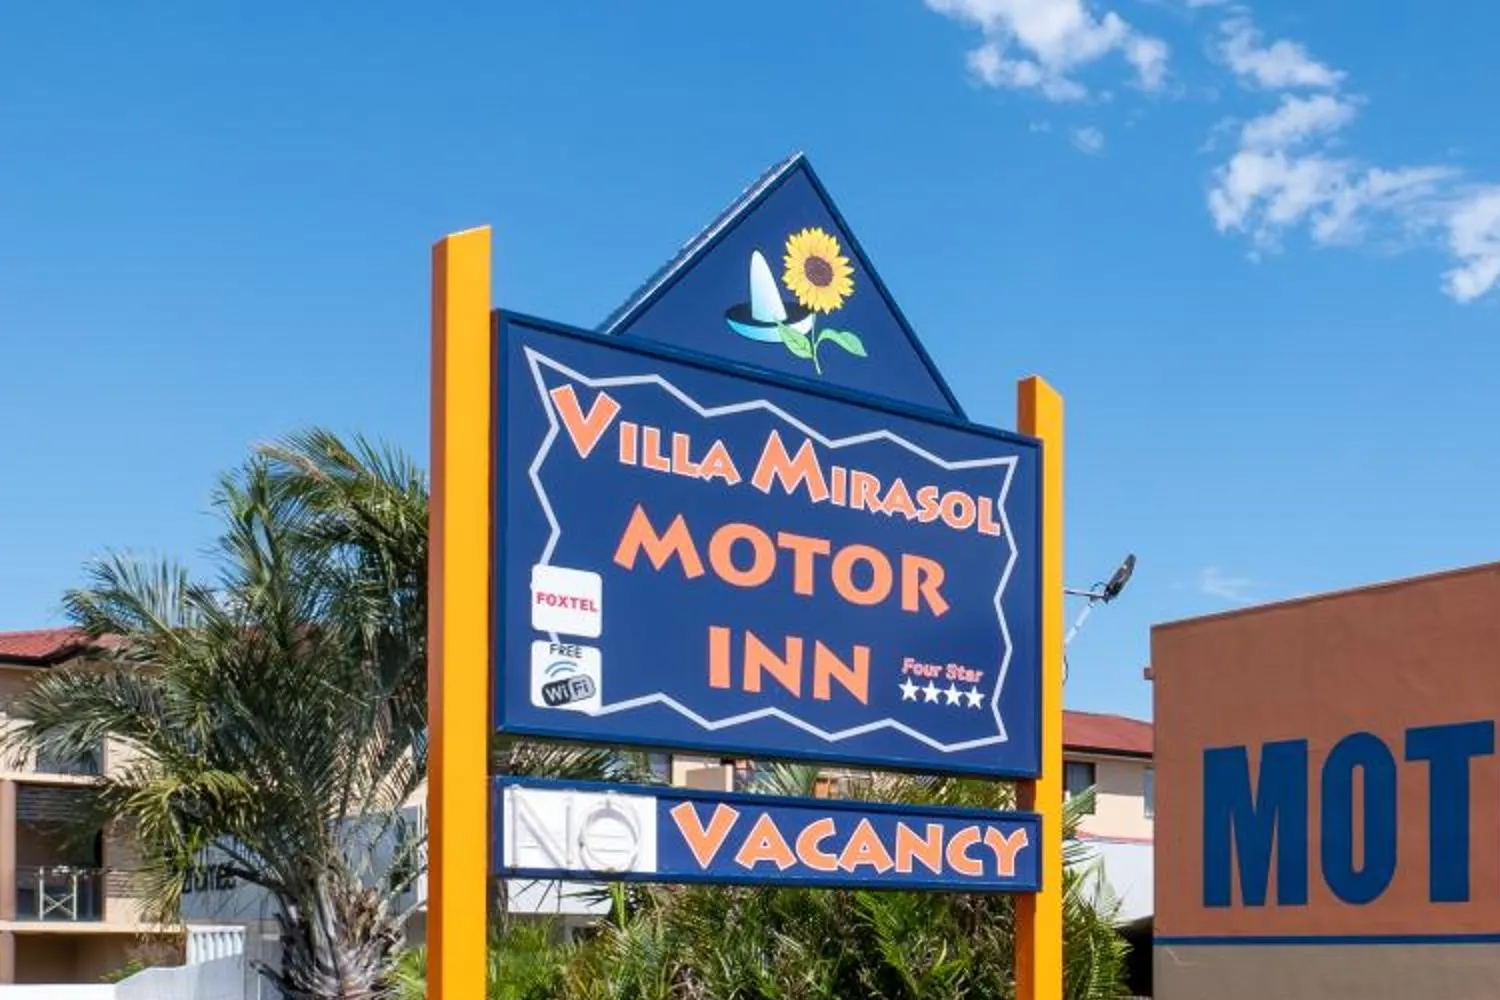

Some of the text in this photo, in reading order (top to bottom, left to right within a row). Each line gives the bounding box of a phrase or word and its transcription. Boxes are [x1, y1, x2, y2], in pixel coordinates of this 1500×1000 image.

[550, 384, 1001, 537] VILLA MIRASOL
[612, 503, 951, 617] MOTOR
[536, 591, 599, 613] FOXTEL
[549, 643, 583, 659] FREE
[708, 625, 870, 705] INN
[902, 657, 984, 683] Four Star
[508, 785, 1028, 877] NO VACANCY
